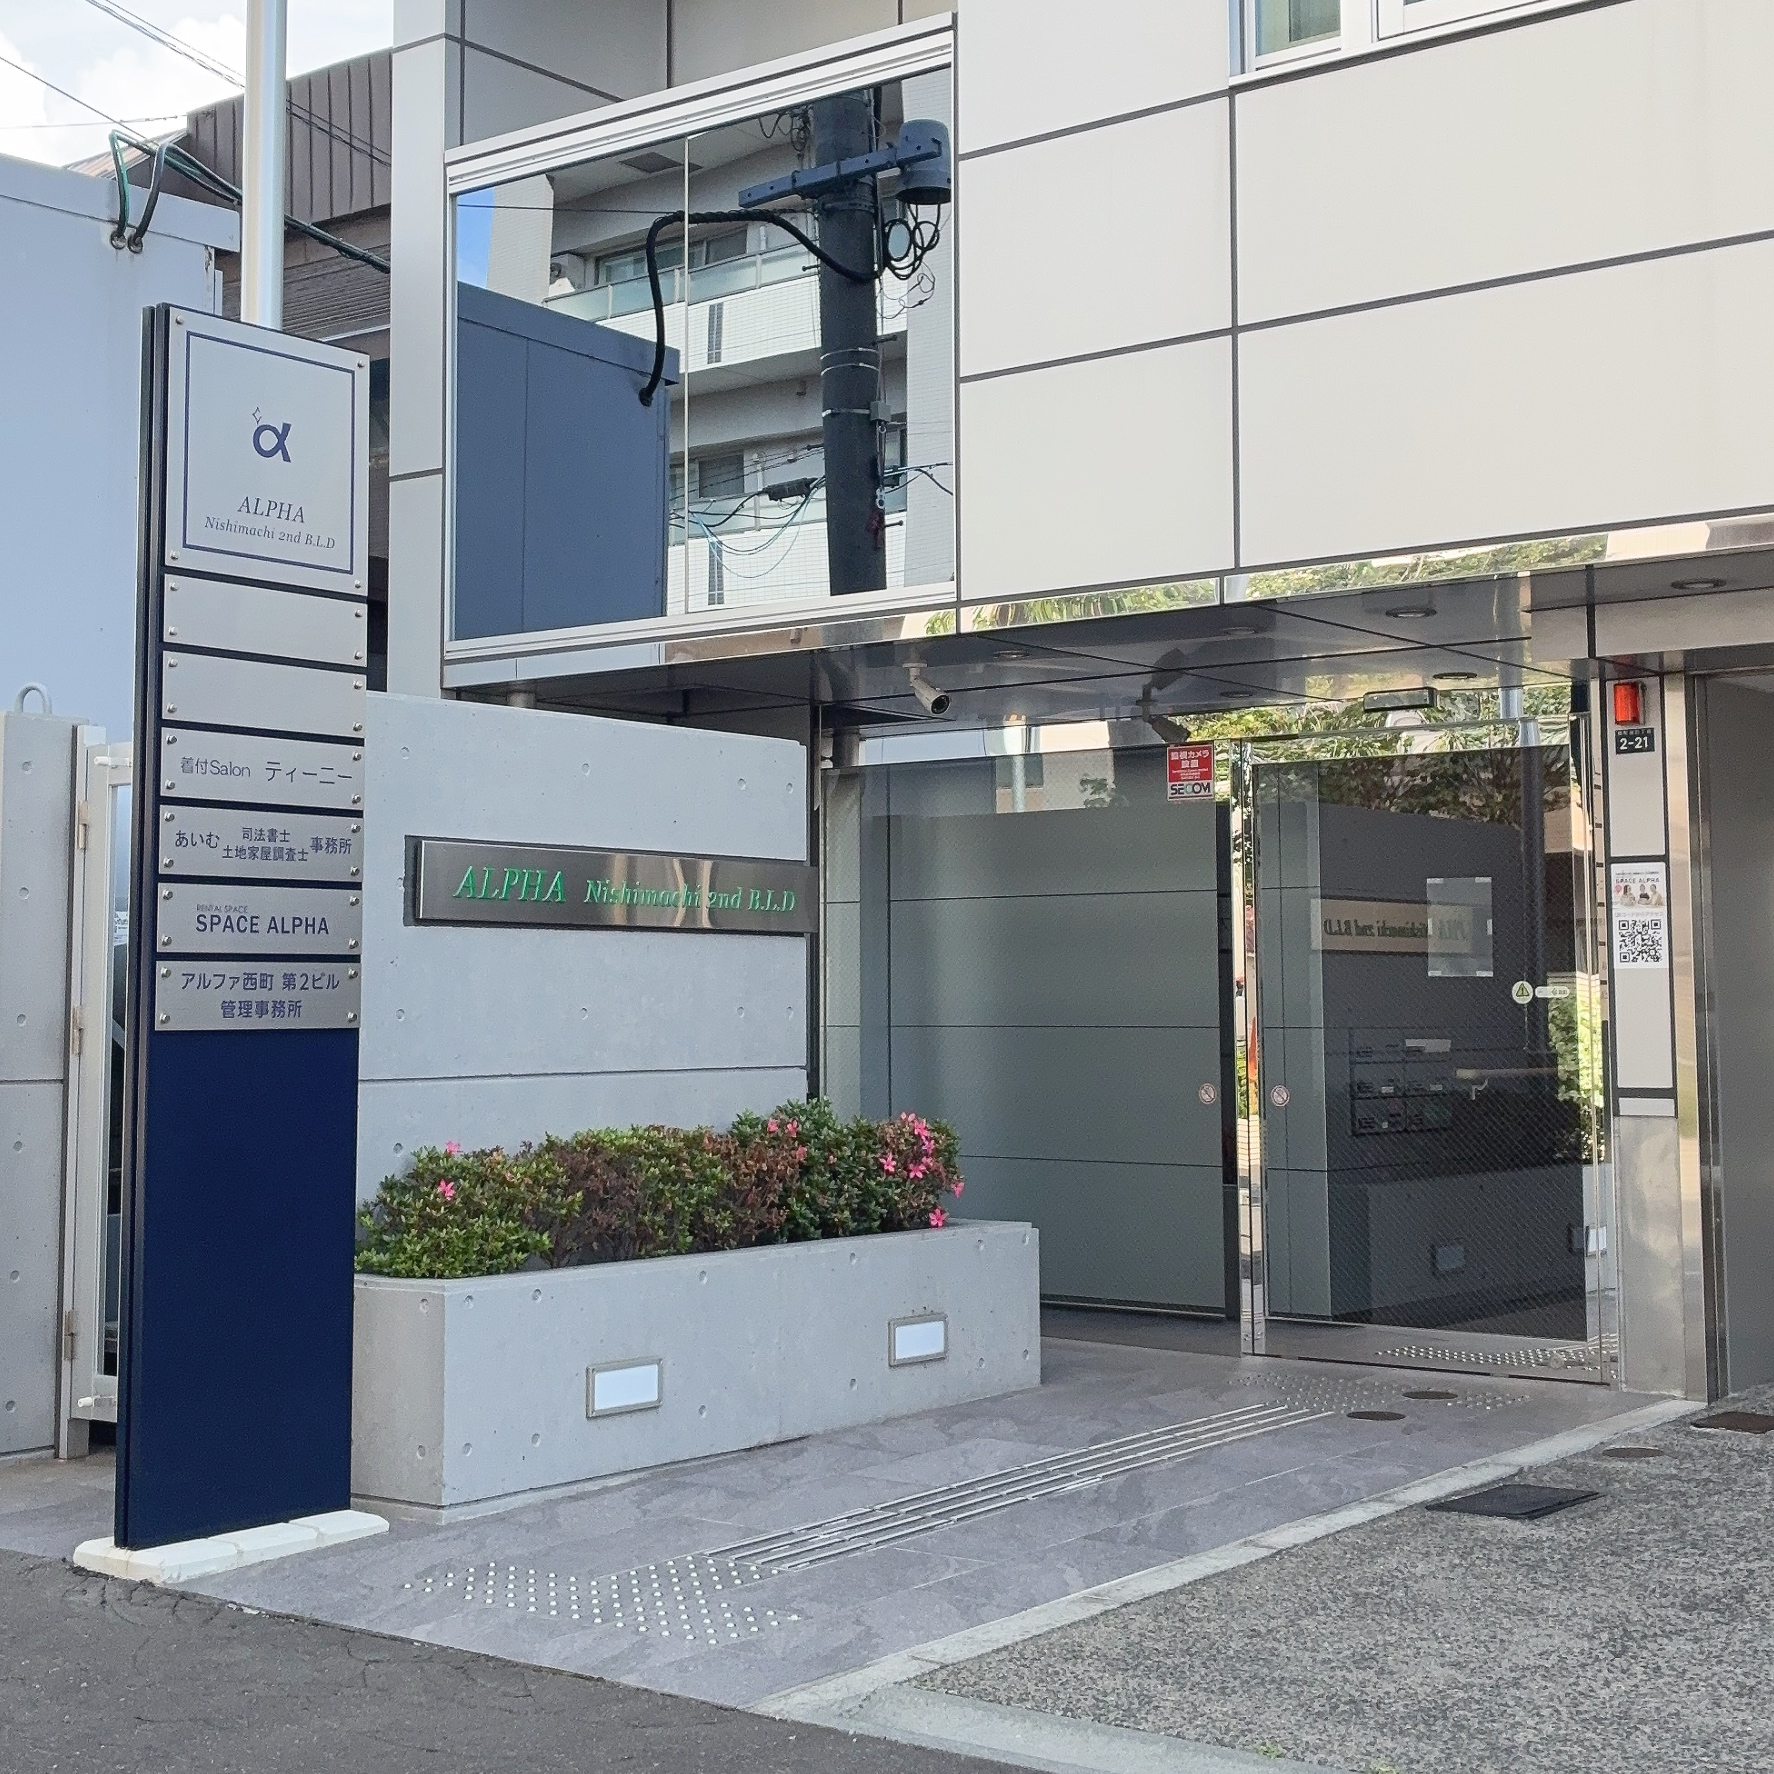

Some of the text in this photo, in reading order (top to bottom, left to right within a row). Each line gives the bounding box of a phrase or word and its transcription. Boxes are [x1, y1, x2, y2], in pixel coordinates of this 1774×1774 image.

[237, 496, 306, 524] ALPHA
[204, 516, 336, 550] Nishimachi 2nd B.L.D
[1619, 736, 1649, 750] 2-21
[265, 761, 353, 785] ティーニー
[1170, 782, 1211, 796] SECOM
[174, 829, 220, 849] あいむ
[242, 827, 291, 843] 司法書士
[221, 845, 309, 862] 土地家屋調査士
[309, 836, 352, 855] 事務所
[453, 865, 798, 912] ALPHA Nishimachi 2nd B.L.D
[196, 914, 329, 935] SPACE ALPHA
[181, 972, 340, 991] アルファ西町 第2ビル
[220, 1000, 303, 1019] 管理事務所
